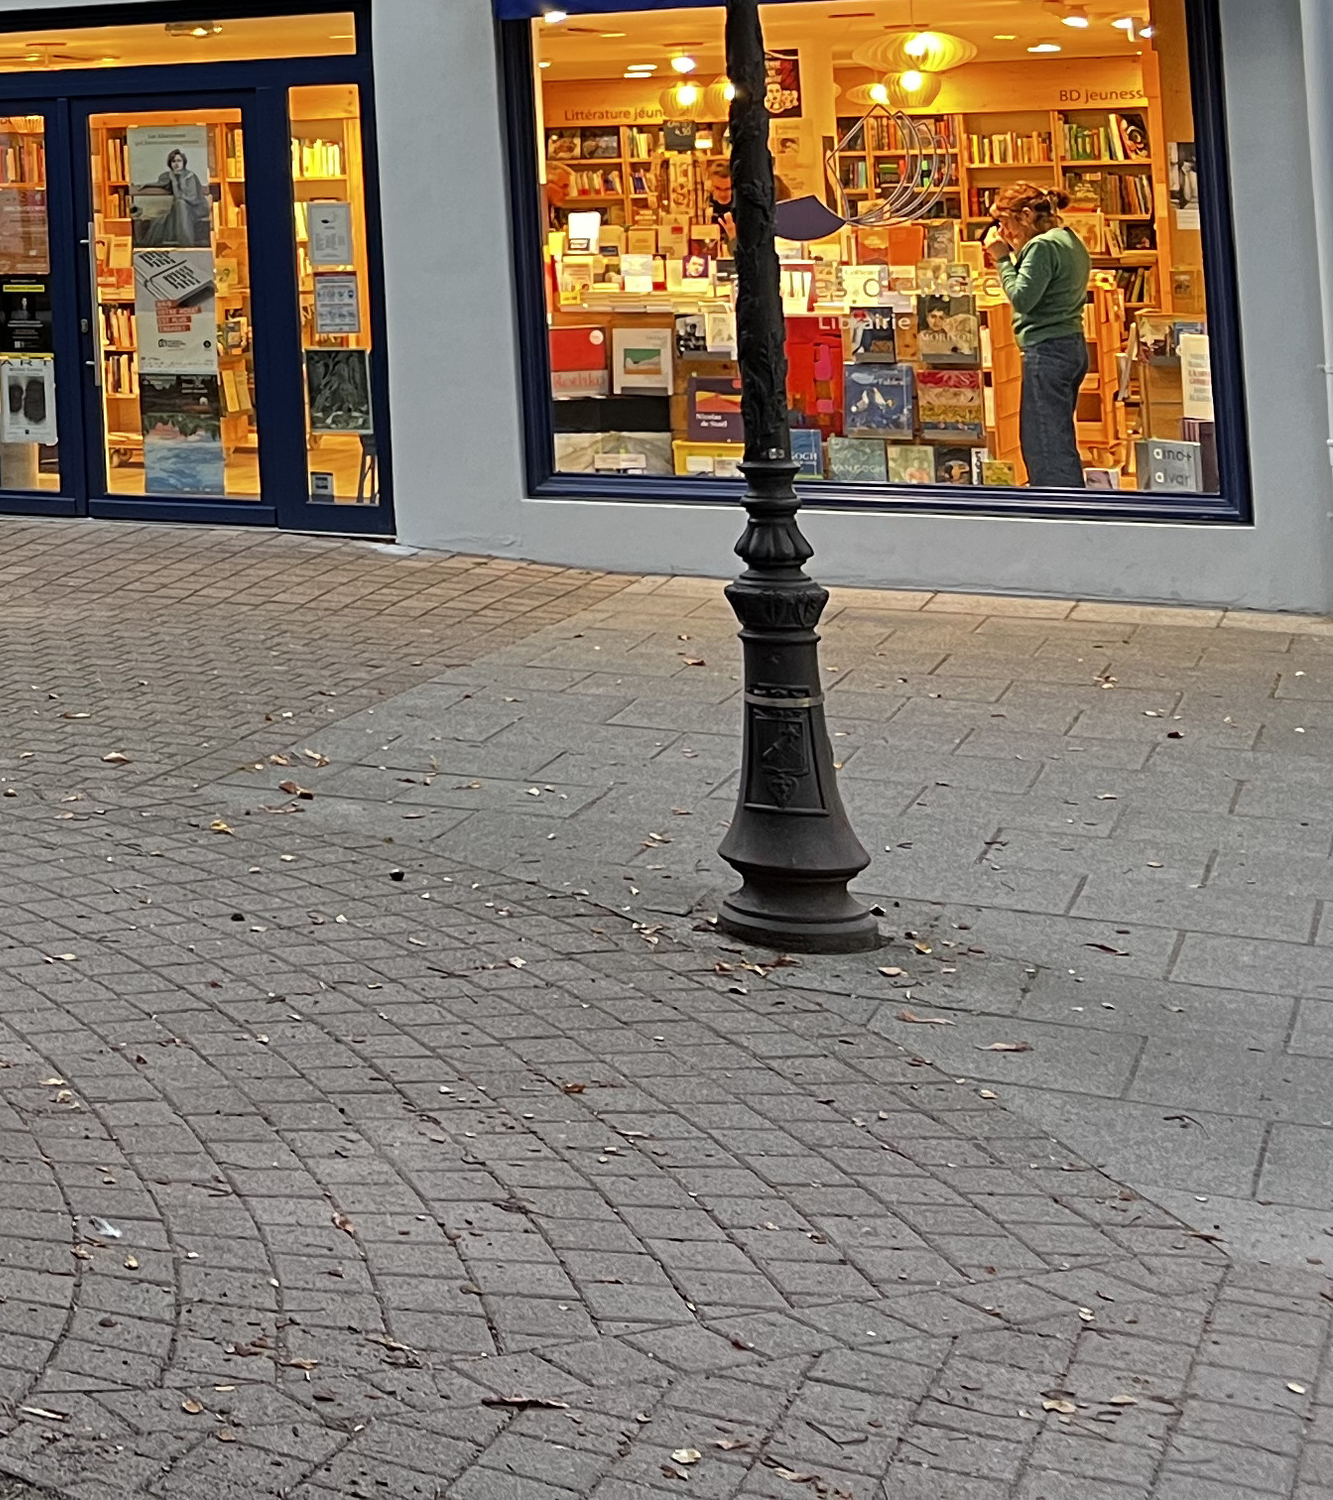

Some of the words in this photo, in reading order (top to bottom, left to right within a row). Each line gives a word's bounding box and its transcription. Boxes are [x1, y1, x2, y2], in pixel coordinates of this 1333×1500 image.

[1059, 89, 1081, 102] BD
[1083, 88, 1143, 104] jeuness
[564, 109, 631, 122] Littérature
[818, 312, 912, 331] Librairie
